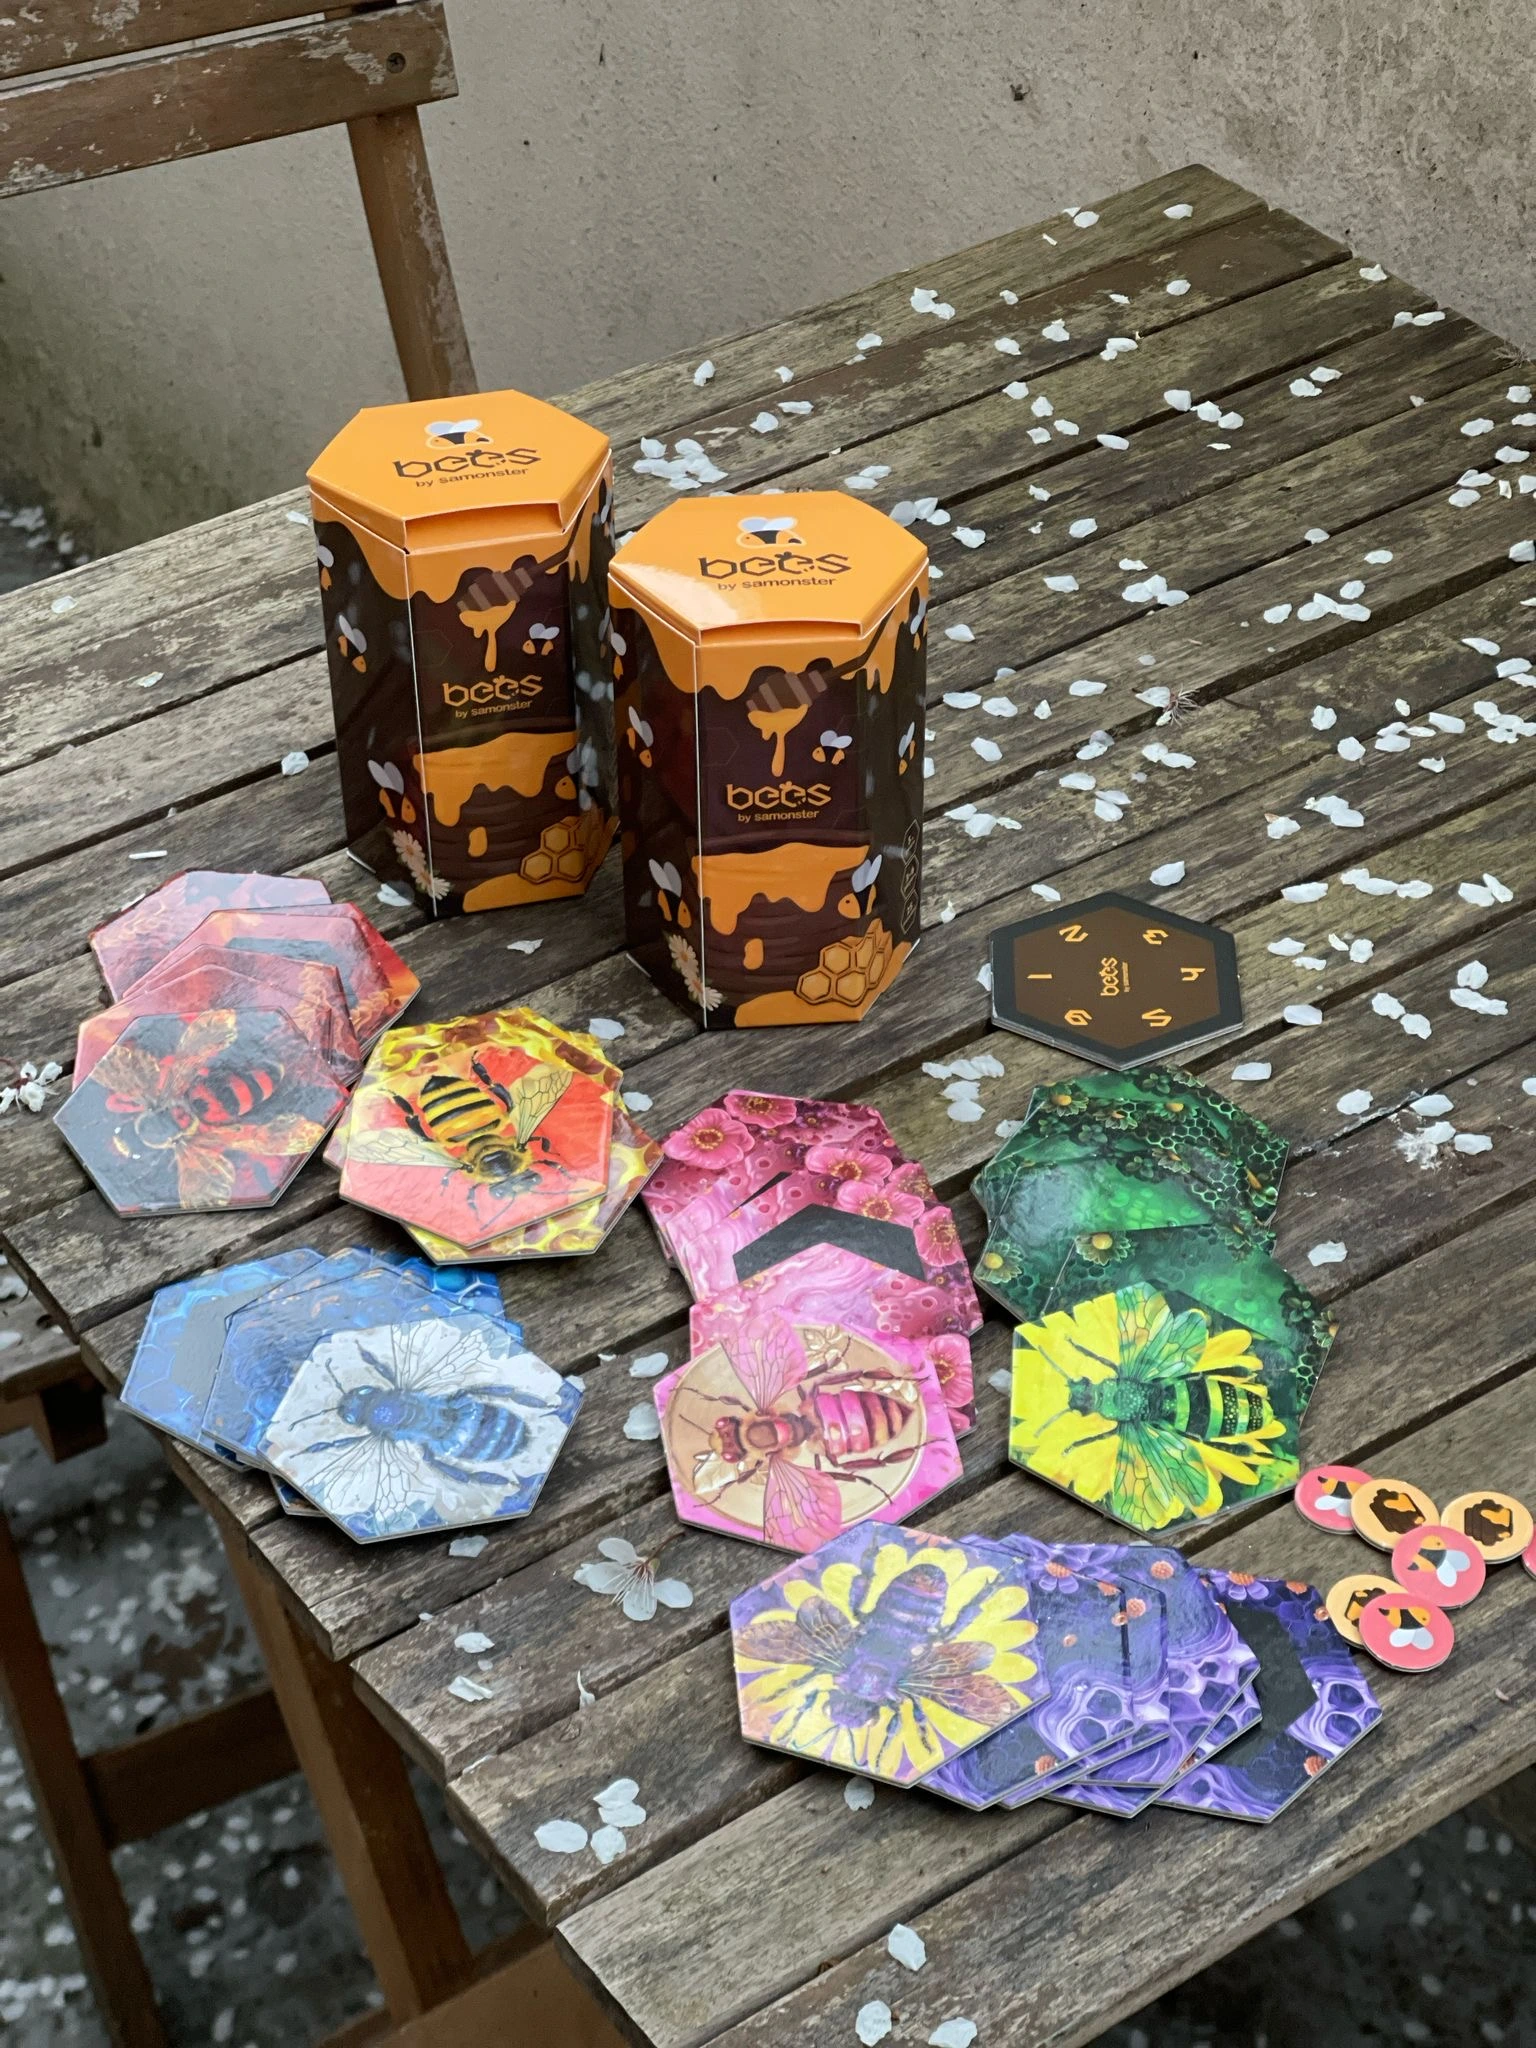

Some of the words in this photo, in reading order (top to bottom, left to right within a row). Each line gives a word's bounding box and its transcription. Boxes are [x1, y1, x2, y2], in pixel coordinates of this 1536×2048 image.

[392, 447, 541, 479] bees
[415, 479, 434, 488] by
[439, 467, 529, 485] samonster
[697, 551, 852, 580] bees
[717, 582, 737, 591] by
[742, 576, 836, 589] samonster
[442, 674, 544, 707] bees
[455, 709, 469, 719] by
[471, 700, 533, 717] samonster
[726, 780, 832, 810] bees
[737, 812, 751, 823] by
[754, 809, 820, 822] samonster
[1099, 956, 1121, 997] bees
